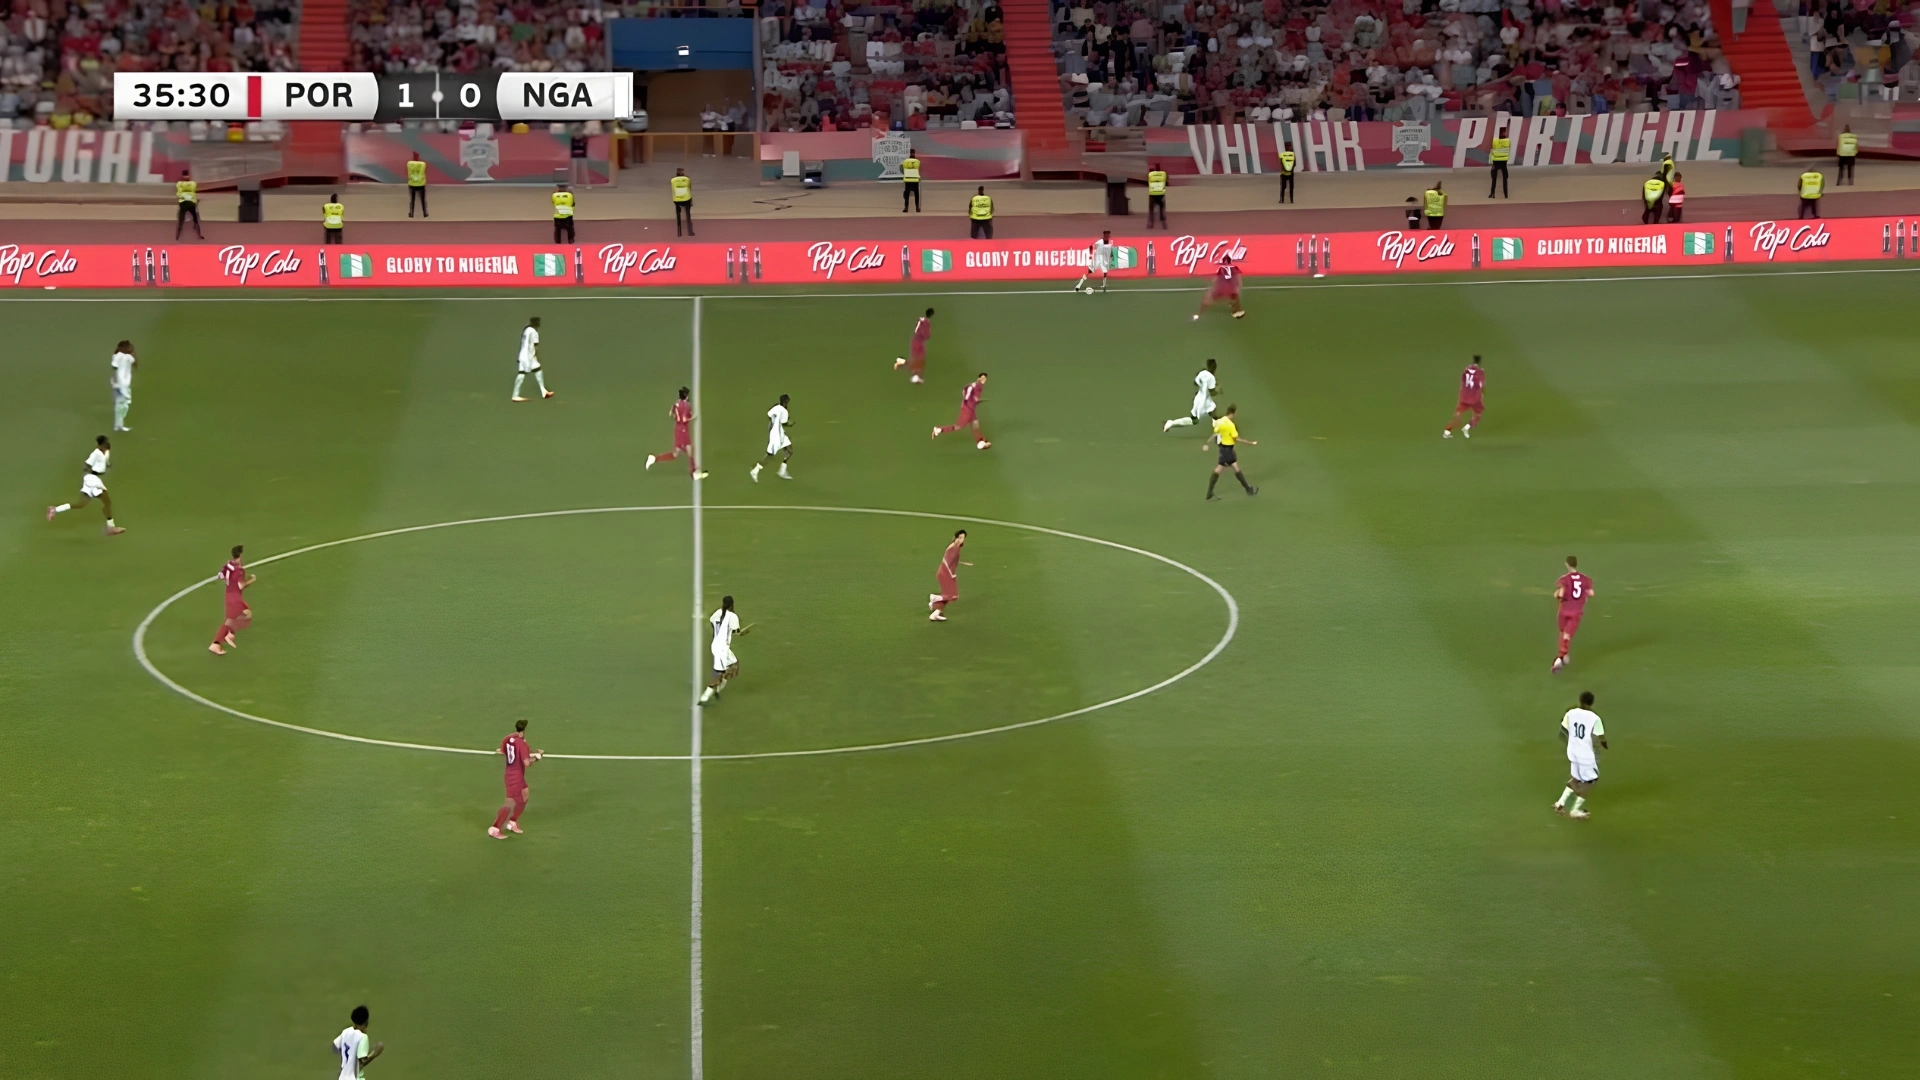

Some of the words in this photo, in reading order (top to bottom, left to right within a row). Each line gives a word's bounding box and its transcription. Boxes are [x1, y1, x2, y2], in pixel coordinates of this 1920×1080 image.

[1170, 235, 1209, 274] Pop
[1376, 231, 1415, 269] Pop
[1415, 234, 1455, 262] Cola
[1586, 237, 1605, 254] TO
[1607, 234, 1667, 254] NIGERIA
[1749, 220, 1790, 260] Pop
[1790, 223, 1832, 251] Cola
[36, 249, 78, 277] Cola
[219, 245, 260, 284] Pop
[261, 249, 302, 277] Cola
[435, 256, 455, 273] TO
[598, 243, 638, 282] Pop
[638, 247, 678, 276] Cola
[807, 241, 846, 279] Pop
[846, 245, 886, 273] Cola
[1013, 250, 1031, 267] TO
[1572, 580, 1582, 598] 5
[1573, 722, 1586, 740] 10
